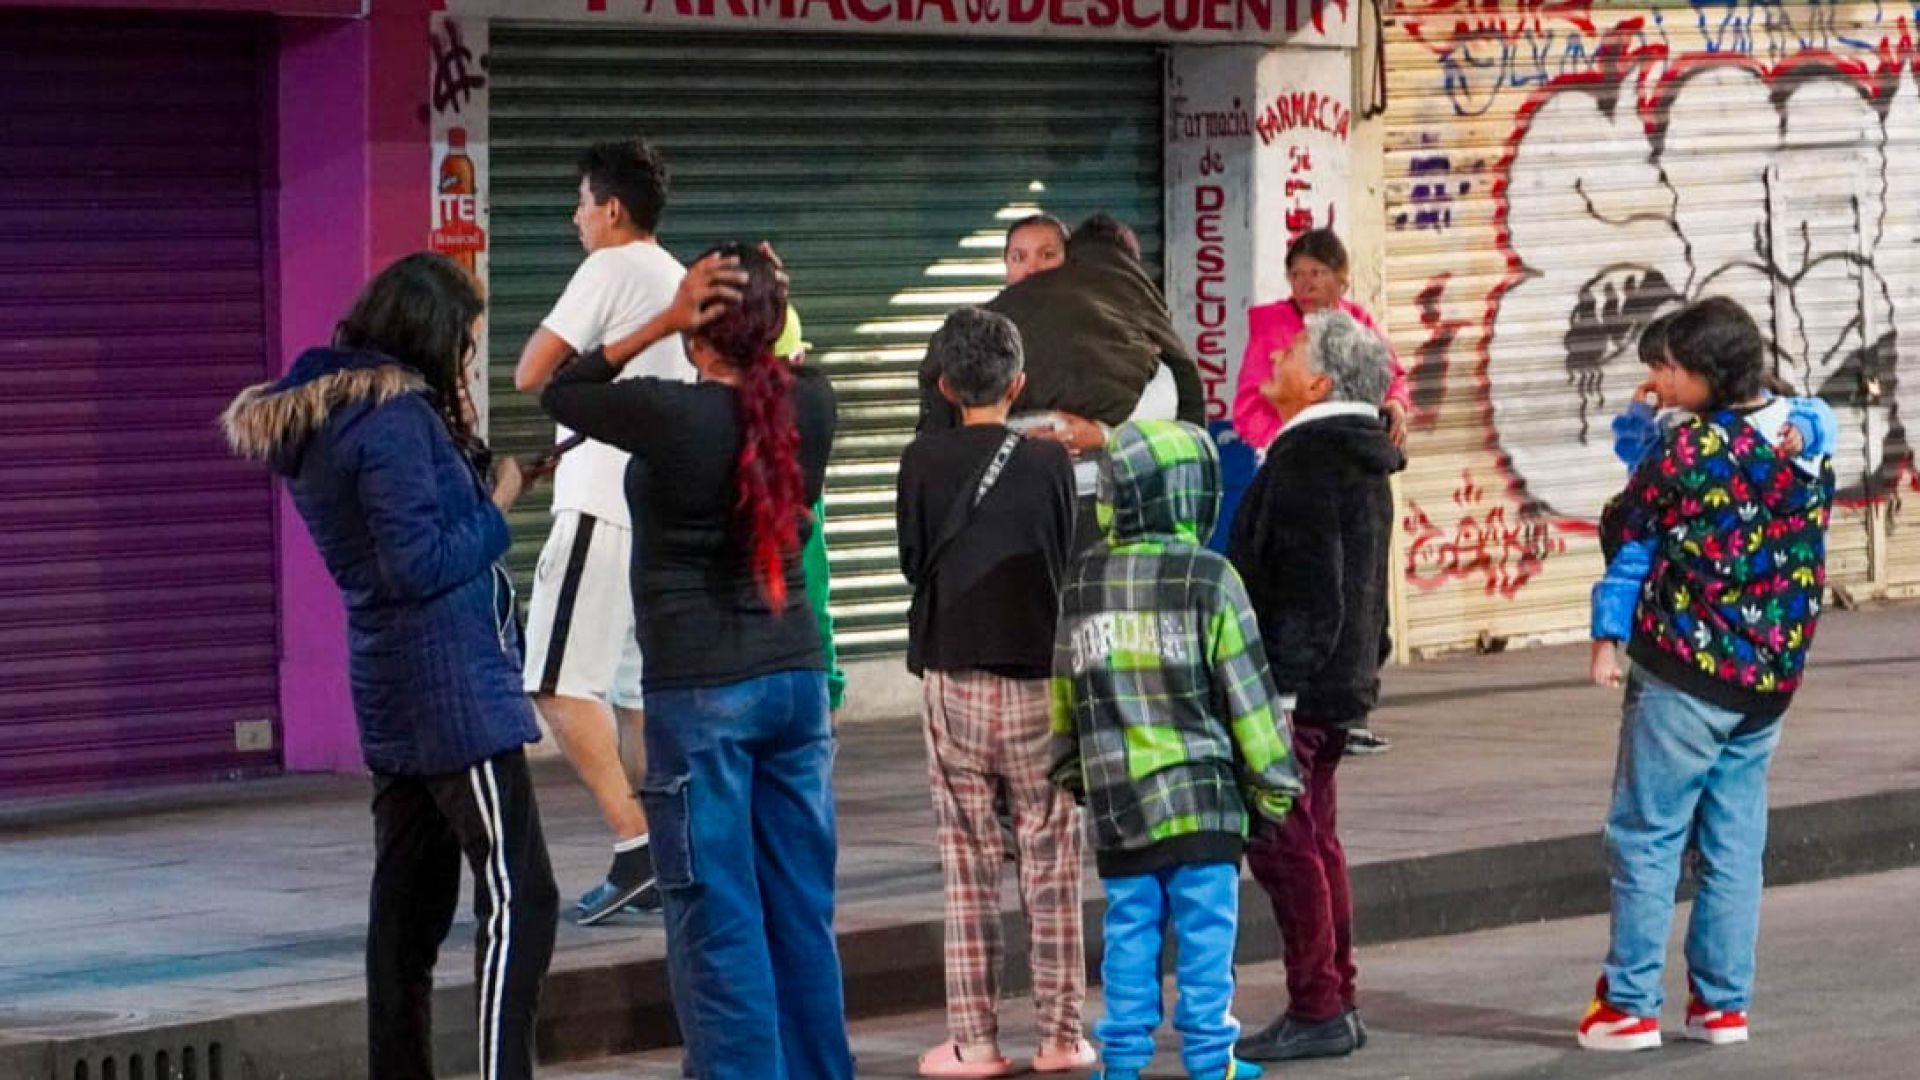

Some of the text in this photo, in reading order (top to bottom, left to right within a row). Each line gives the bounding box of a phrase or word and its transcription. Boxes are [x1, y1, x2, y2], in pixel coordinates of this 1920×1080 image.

[587, 0, 958, 23] MACIA
[1169, 96, 1251, 142] Farmacia
[1200, 145, 1225, 177] de
